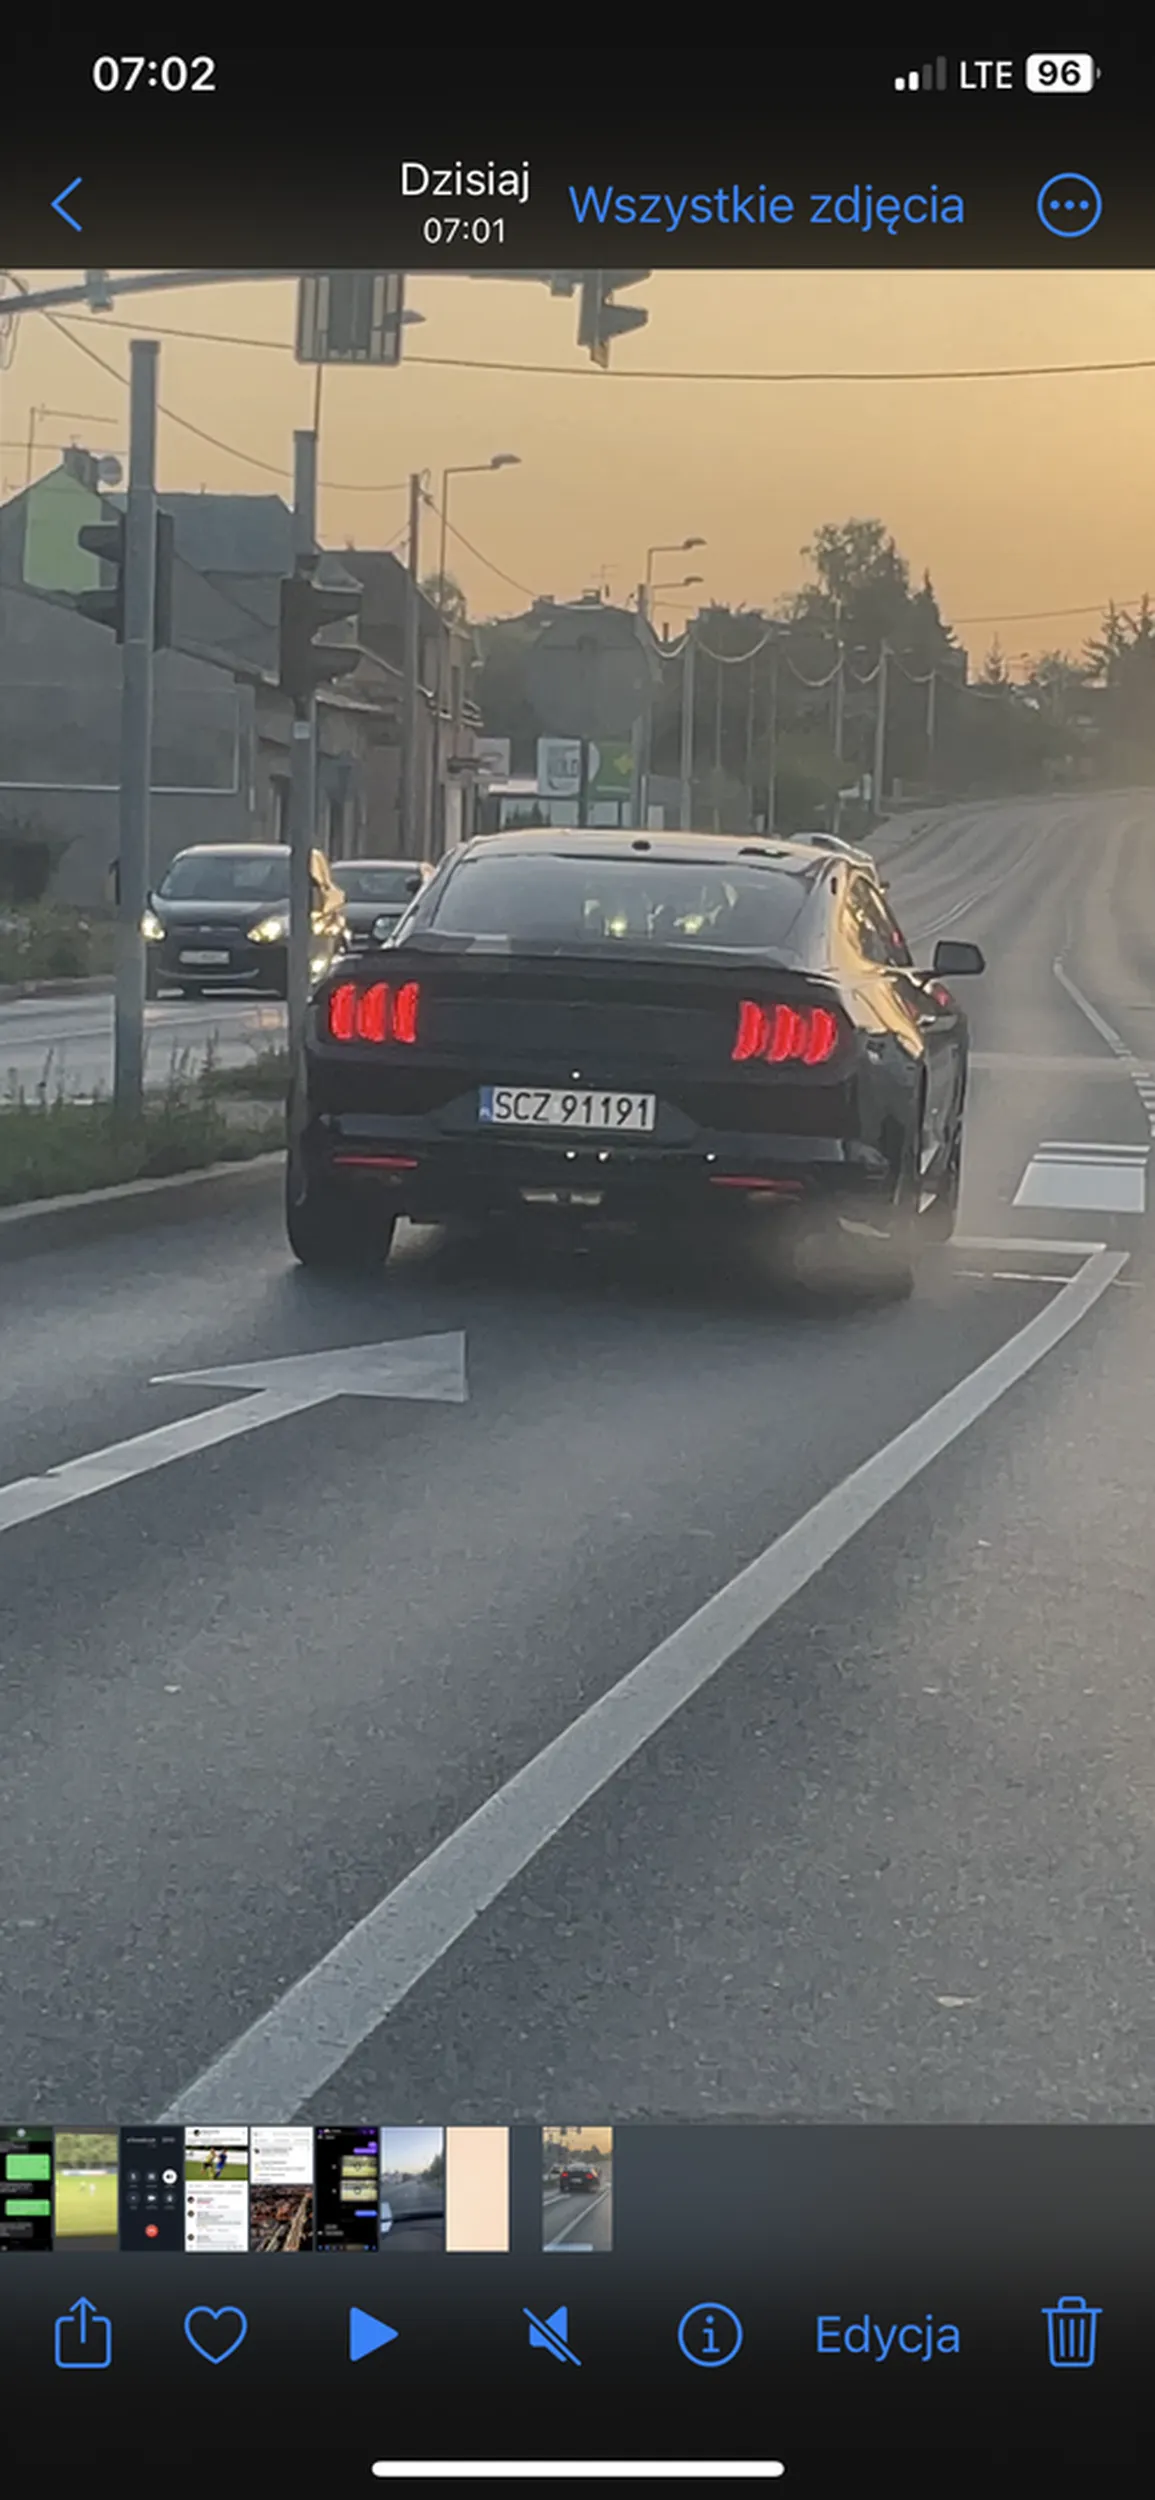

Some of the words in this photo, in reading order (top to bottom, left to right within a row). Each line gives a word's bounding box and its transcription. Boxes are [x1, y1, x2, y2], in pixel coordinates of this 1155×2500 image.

[93, 56, 215, 91] 07:02
[961, 61, 1012, 89] LTE
[1038, 60, 1081, 87] 96
[402, 161, 529, 203] Dzisiaj
[569, 184, 794, 232] Wszystkie
[810, 184, 964, 234] zdjęcia
[424, 217, 505, 243] 07:01
[495, 1091, 551, 1122] SCZ
[561, 1095, 648, 1126] 91191
[817, 2314, 960, 2362] Edycja
